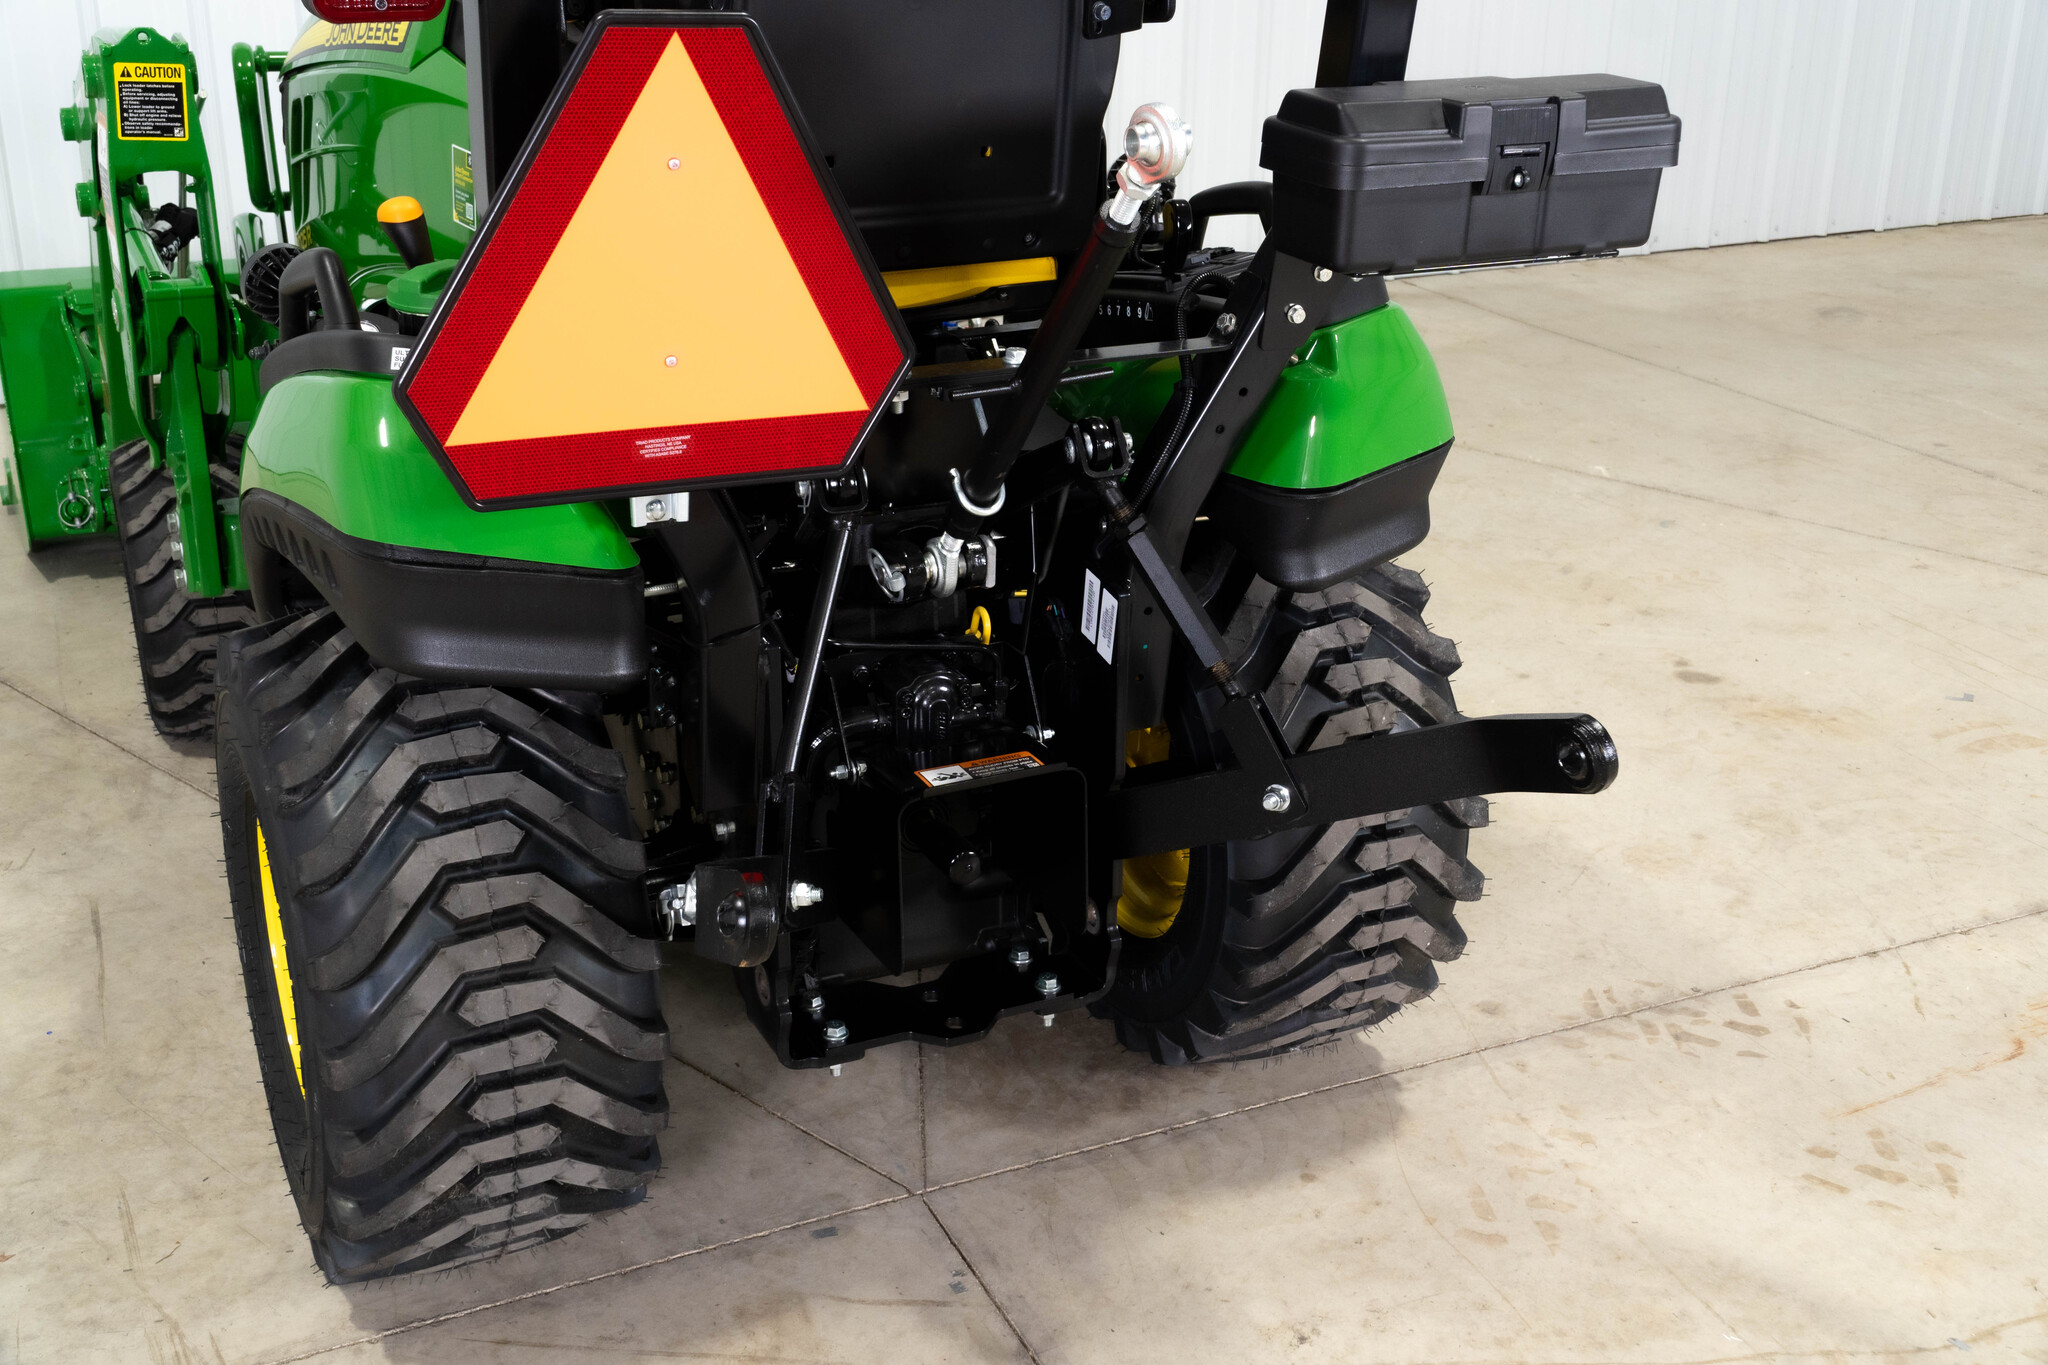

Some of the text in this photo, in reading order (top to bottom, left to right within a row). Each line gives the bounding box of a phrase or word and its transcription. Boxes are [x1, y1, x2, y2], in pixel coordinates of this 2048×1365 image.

[326, 22, 401, 43] JOHN DEERE
[135, 66, 181, 78] CAUTION
[1099, 304, 1142, 318] 5 6 7 8 9
[979, 754, 1021, 764] WARNING
